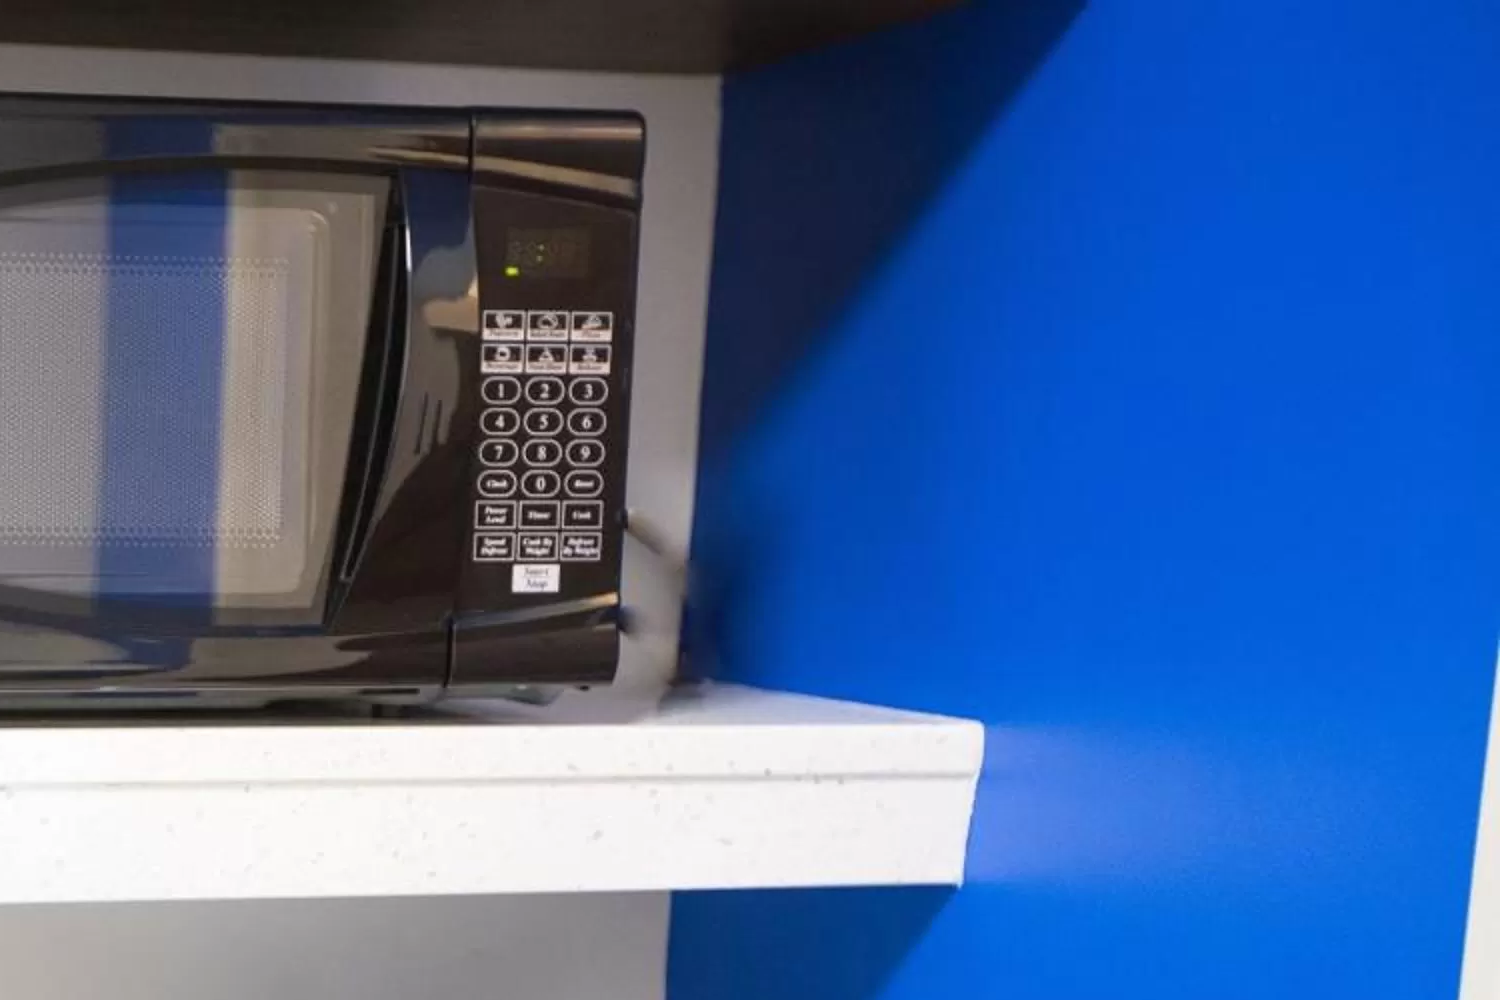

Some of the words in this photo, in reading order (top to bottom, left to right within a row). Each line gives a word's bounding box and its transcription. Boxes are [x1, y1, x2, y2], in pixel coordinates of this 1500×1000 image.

[497, 383, 505, 399] 1
[539, 383, 550, 399] 2
[583, 383, 593, 399] 3
[495, 414, 505, 429] 4
[539, 414, 549, 429] 5
[582, 415, 592, 430] 6
[494, 445, 504, 460] 7
[537, 446, 547, 461] 8
[581, 446, 591, 461] 9
[535, 476, 546, 491] 0
